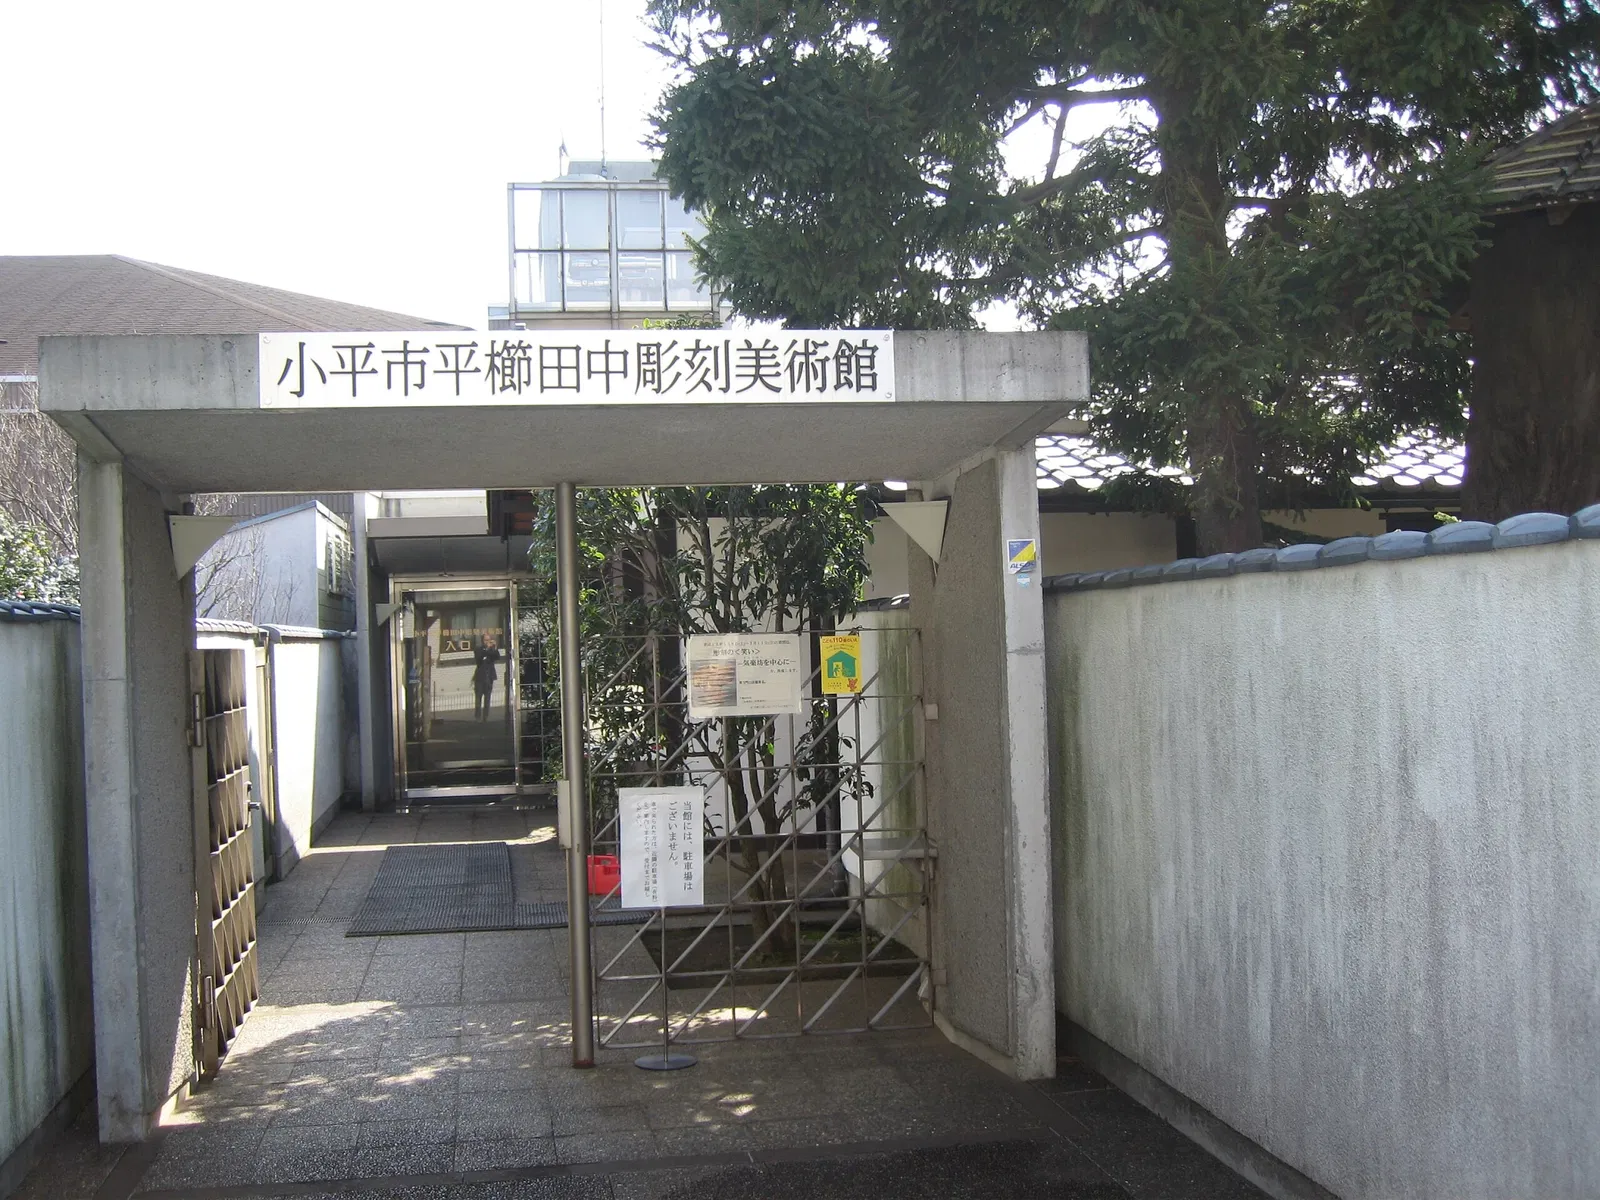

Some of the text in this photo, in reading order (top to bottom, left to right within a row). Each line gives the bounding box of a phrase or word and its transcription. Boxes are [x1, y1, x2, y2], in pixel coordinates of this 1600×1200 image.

[277, 338, 879, 398] 小平市平櫛田中彫刻美術館
[445, 640, 471, 651] 入口
[668, 801, 678, 866] ございません。
[683, 801, 693, 891] 当館には、駐車場は
